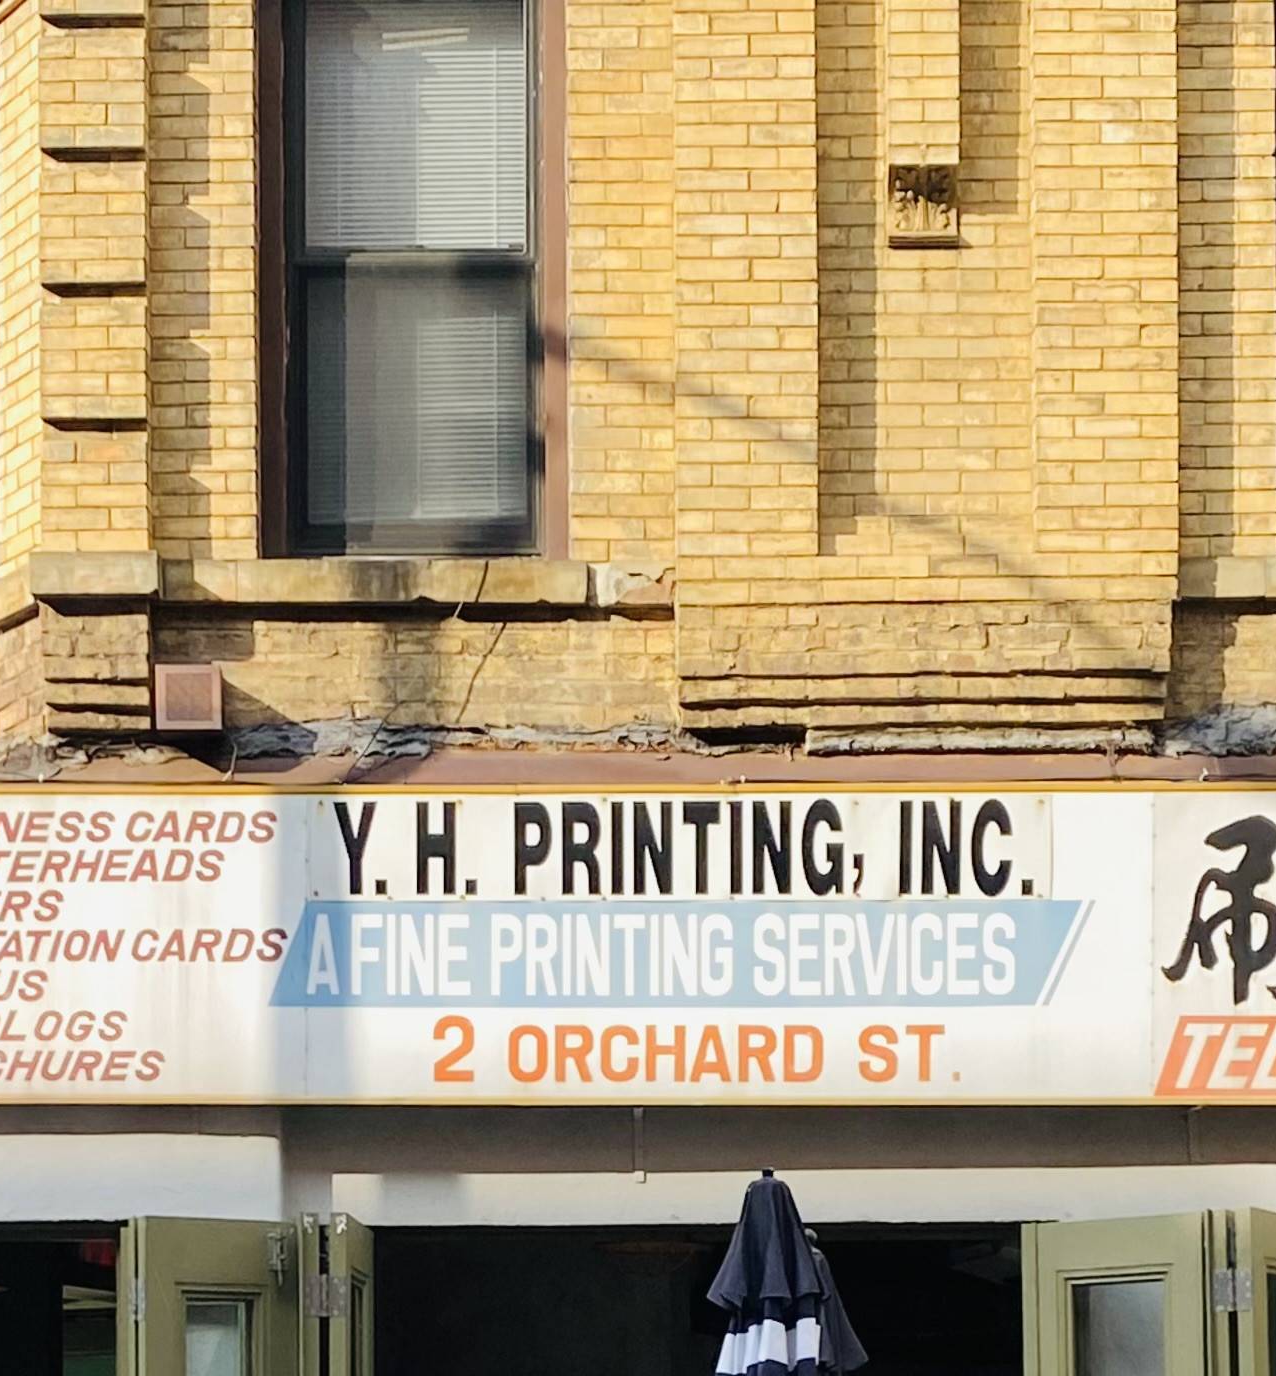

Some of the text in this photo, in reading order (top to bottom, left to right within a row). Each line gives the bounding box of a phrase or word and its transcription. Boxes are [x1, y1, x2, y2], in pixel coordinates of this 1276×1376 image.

[125, 811, 278, 844] CARDS
[332, 799, 1035, 897] Y. H. PRINTING, INC.
[130, 928, 289, 964] CARDS
[306, 912, 1016, 998] A FINE PRINTING SERVICES
[432, 1014, 962, 1084] 2 ORCHARD ST.
